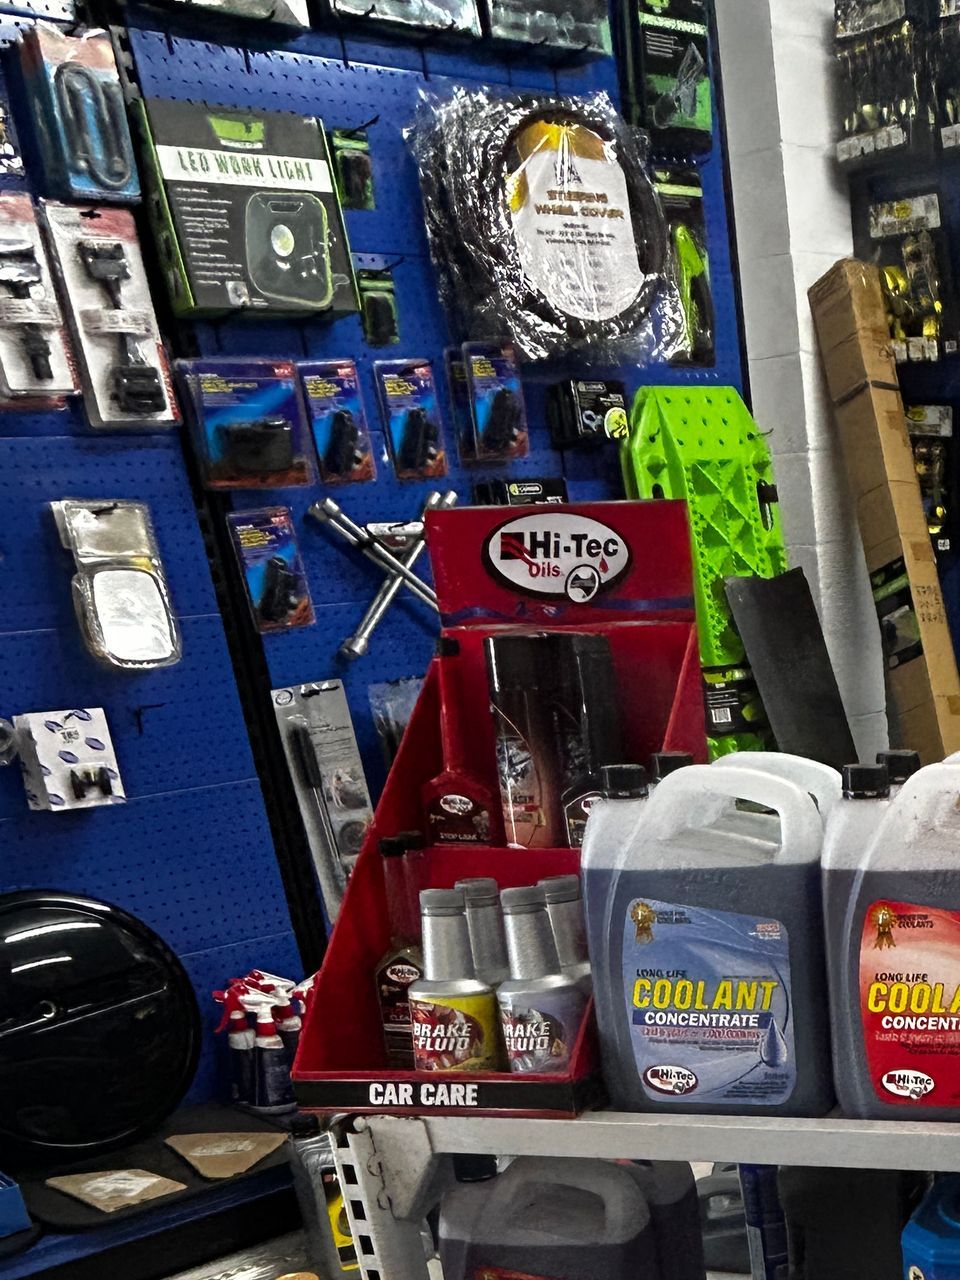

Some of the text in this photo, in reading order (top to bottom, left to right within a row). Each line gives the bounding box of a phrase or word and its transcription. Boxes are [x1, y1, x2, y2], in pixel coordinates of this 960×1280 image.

[529, 531, 619, 559] Hi-Tec
[529, 562, 560, 578] Oils
[875, 973, 928, 983] LONG LIFE
[632, 977, 780, 1011] COOLANT
[644, 1012, 760, 1027] CONCENTRATE
[414, 1023, 472, 1037] BRAKE
[417, 1037, 470, 1051] FLUID
[369, 1083, 478, 1106] CAR CARE
